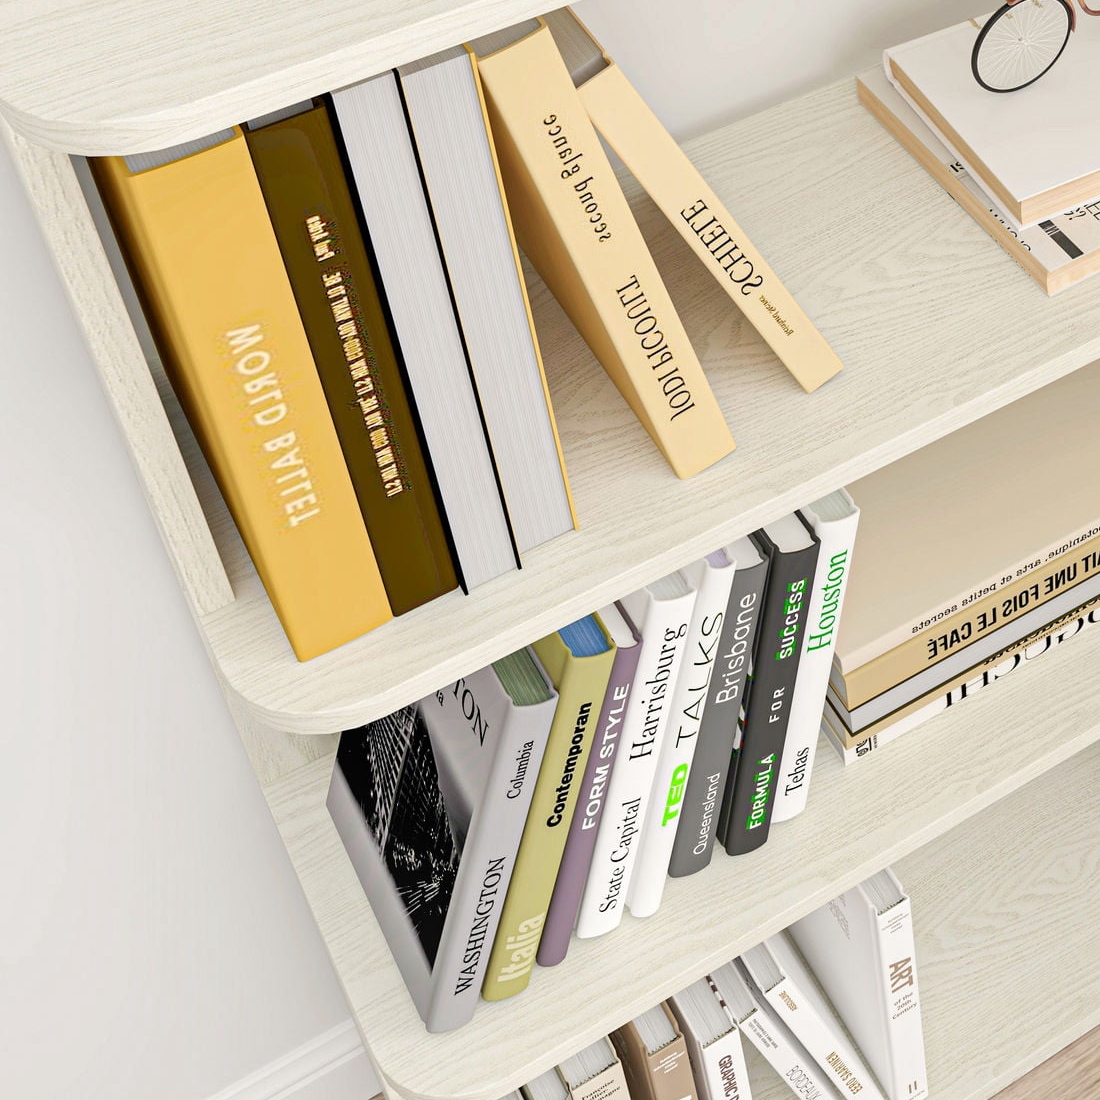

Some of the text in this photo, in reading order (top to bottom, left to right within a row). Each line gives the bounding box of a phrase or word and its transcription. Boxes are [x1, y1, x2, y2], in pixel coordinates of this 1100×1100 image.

[716, 592, 757, 704] Brisbane
[806, 548, 848, 653] Houston
[629, 623, 687, 761] Harrisburg
[662, 611, 724, 826] TED TALKS
[746, 579, 807, 830] FORMULA FOR SUCCESS
[581, 683, 630, 830] FORM STYLE
[693, 772, 721, 855] Queensland
[785, 746, 809, 796] Tehas
[454, 740, 534, 996] WASHINGTON Columbia
[497, 701, 592, 983] Italia Contemporan
[600, 796, 642, 913] State Capital
[889, 956, 914, 994] ART
[892, 1002, 917, 1020] Century
